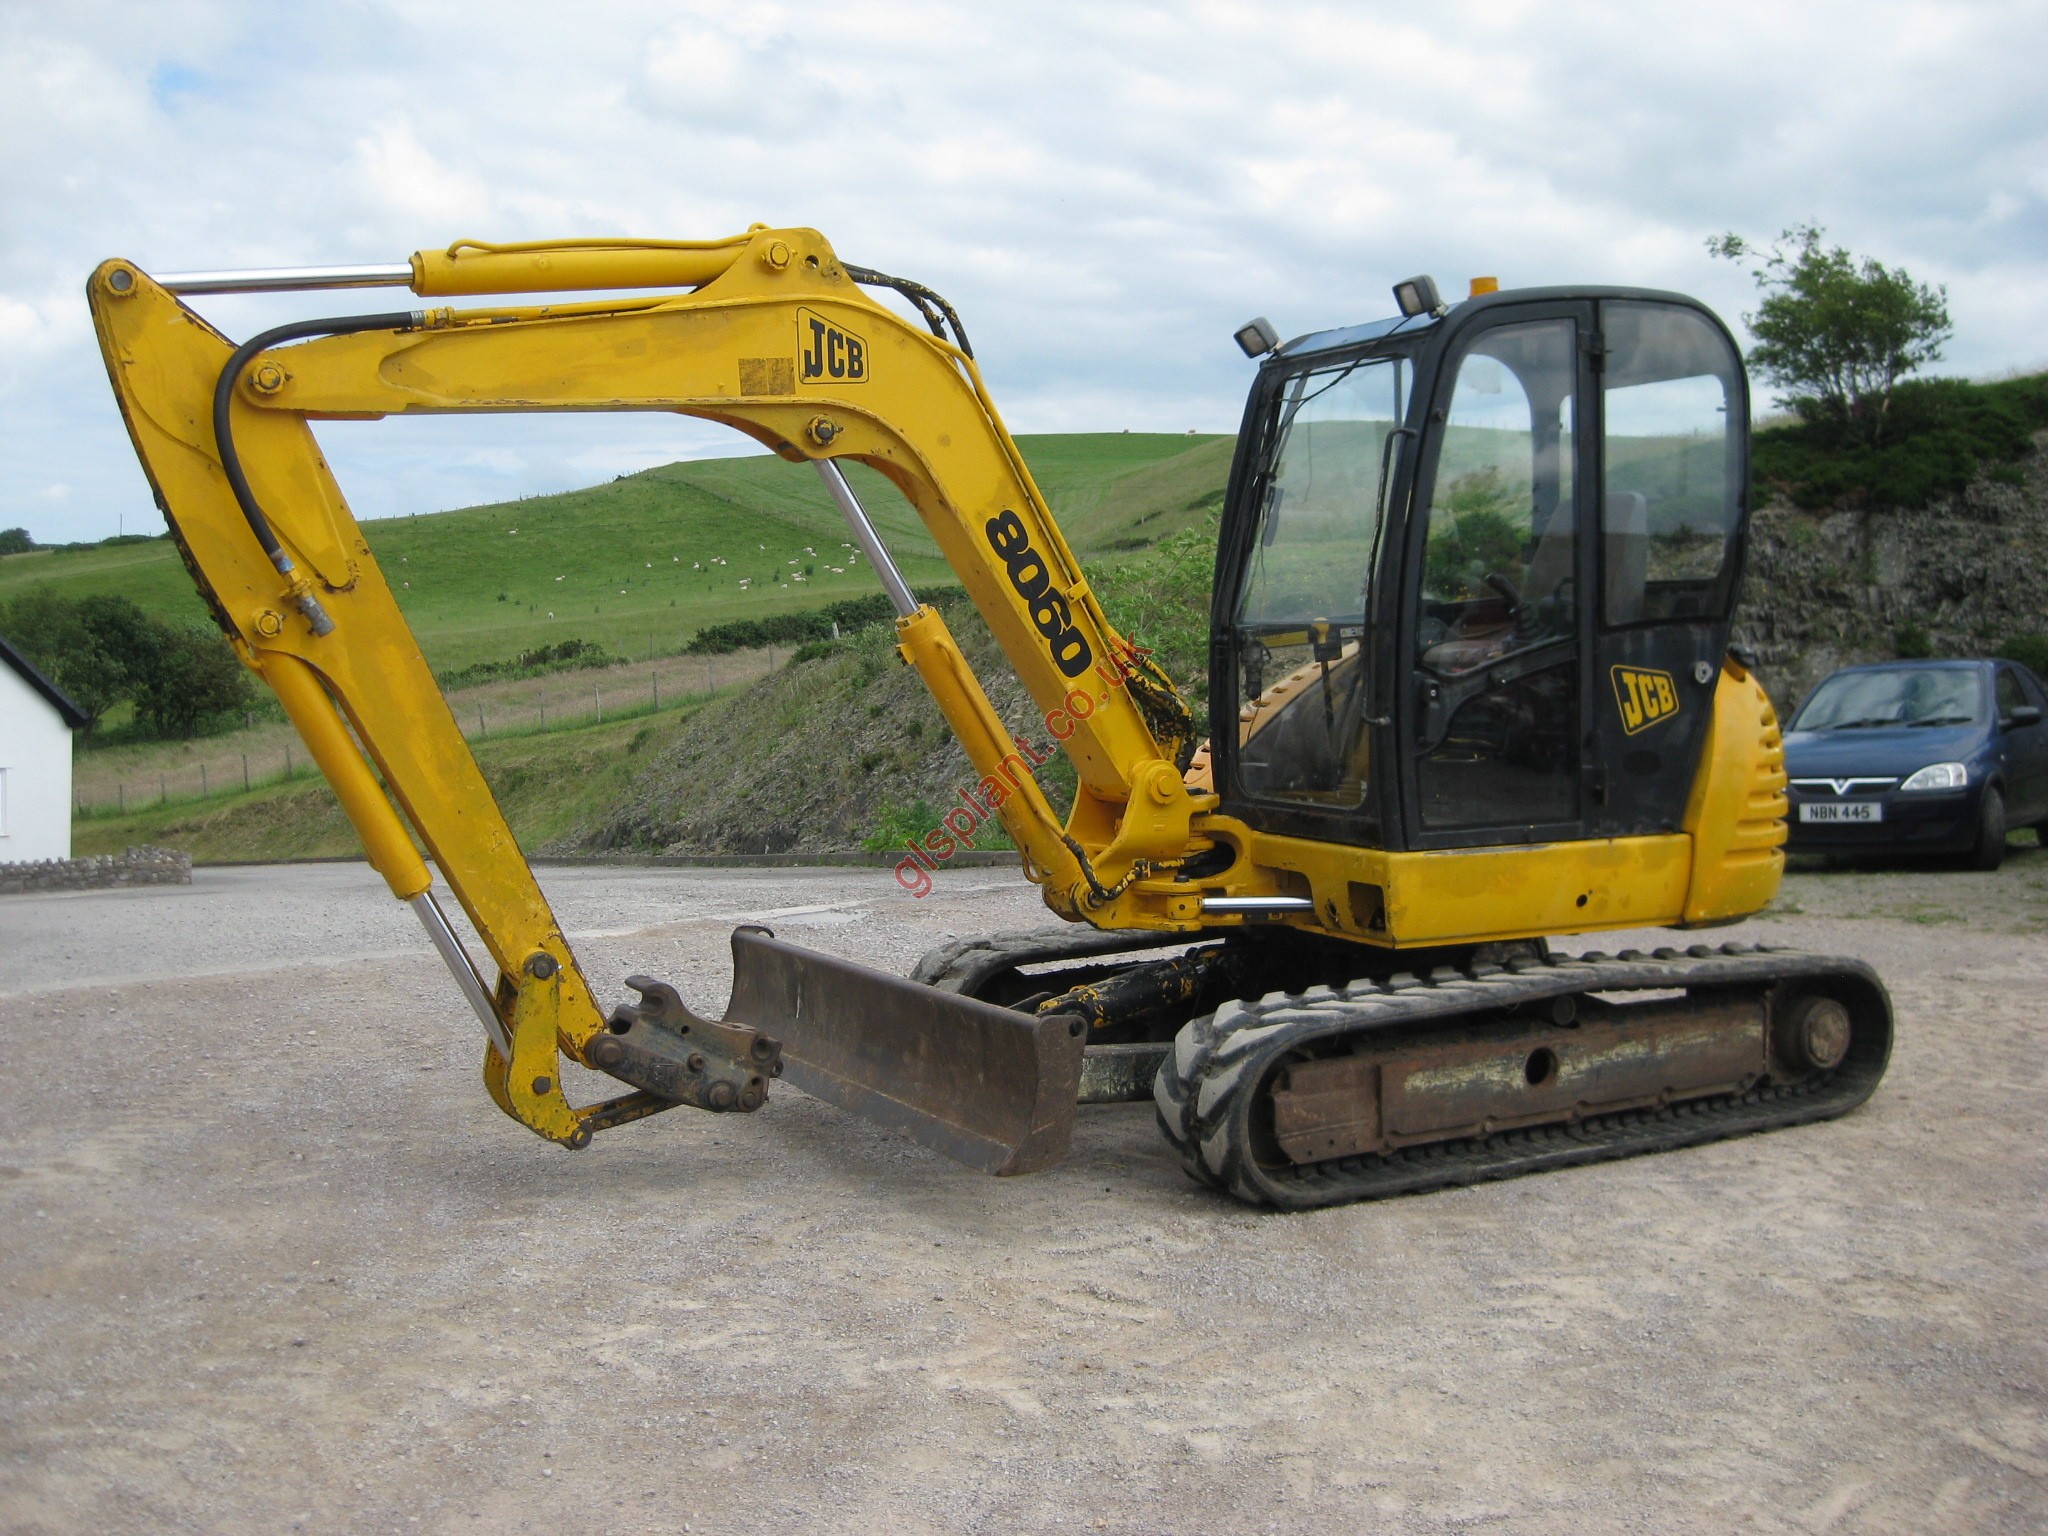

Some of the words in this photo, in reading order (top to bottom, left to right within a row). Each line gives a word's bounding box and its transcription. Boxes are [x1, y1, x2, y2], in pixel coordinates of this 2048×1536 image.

[804, 317, 864, 379] JCB
[985, 509, 1093, 678] 8060
[1621, 671, 1674, 728] JCB
[1809, 806, 1837, 819] NBN
[1841, 806, 1870, 819] 445
